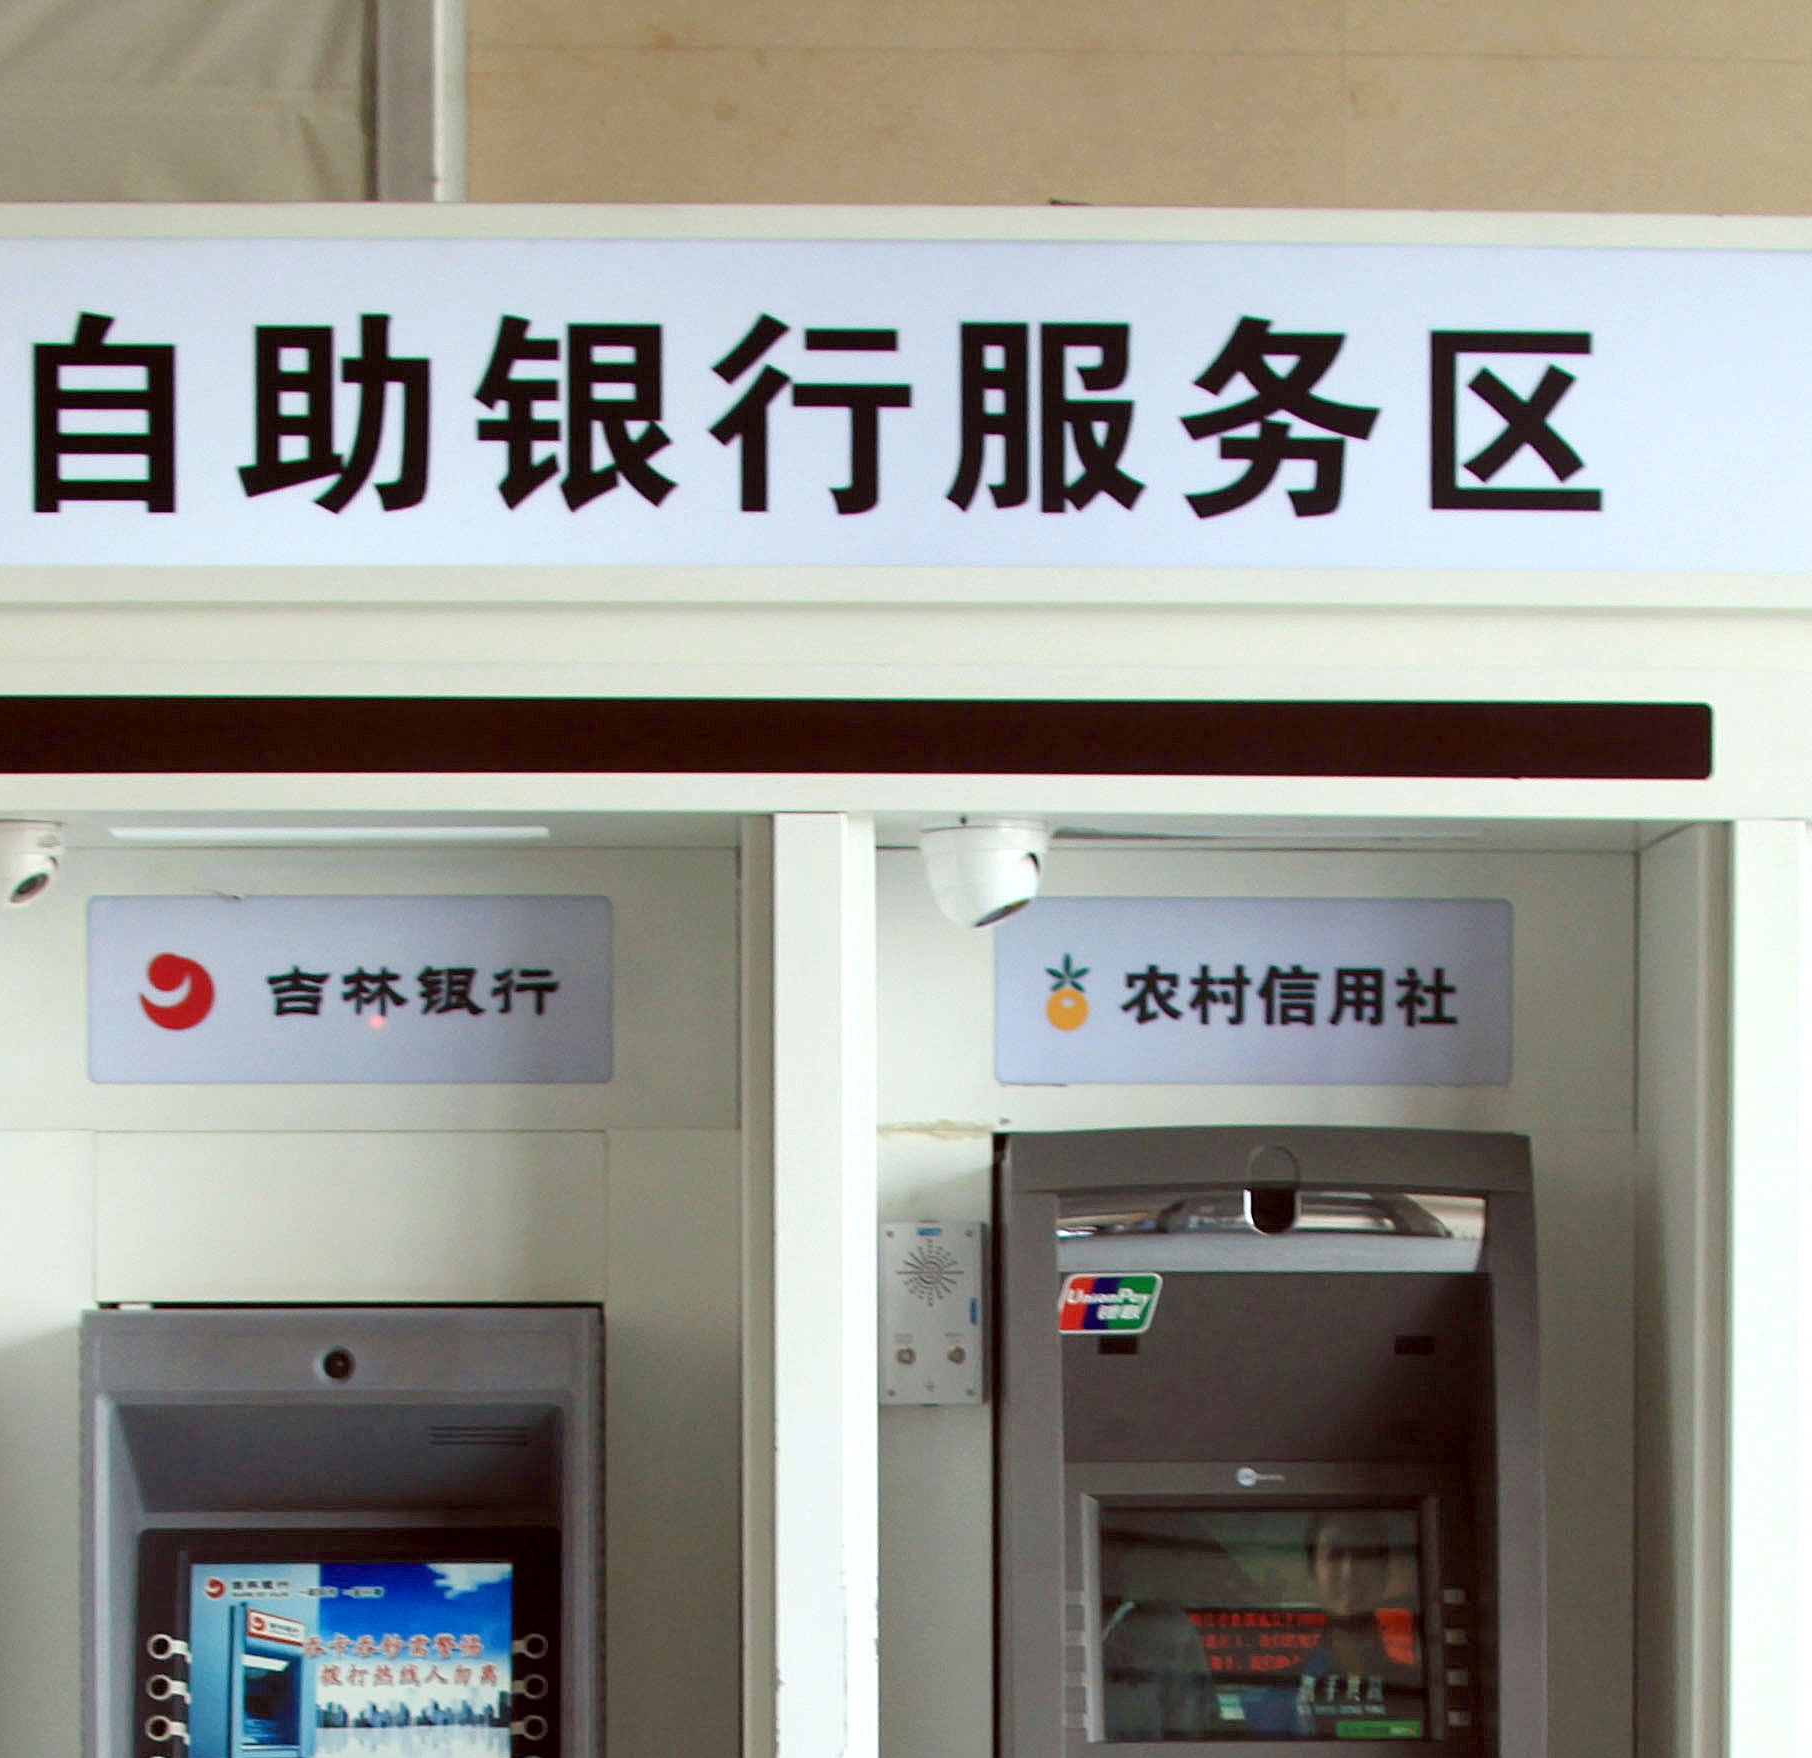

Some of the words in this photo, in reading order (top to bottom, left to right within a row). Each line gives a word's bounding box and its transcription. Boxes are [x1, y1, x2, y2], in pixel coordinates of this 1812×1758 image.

[29, 310, 1604, 520] 自助银行服务区
[266, 964, 562, 1017] 吉林银行
[1120, 963, 1461, 1028] 农村信用社
[1066, 1287, 1151, 1307] UnionPay
